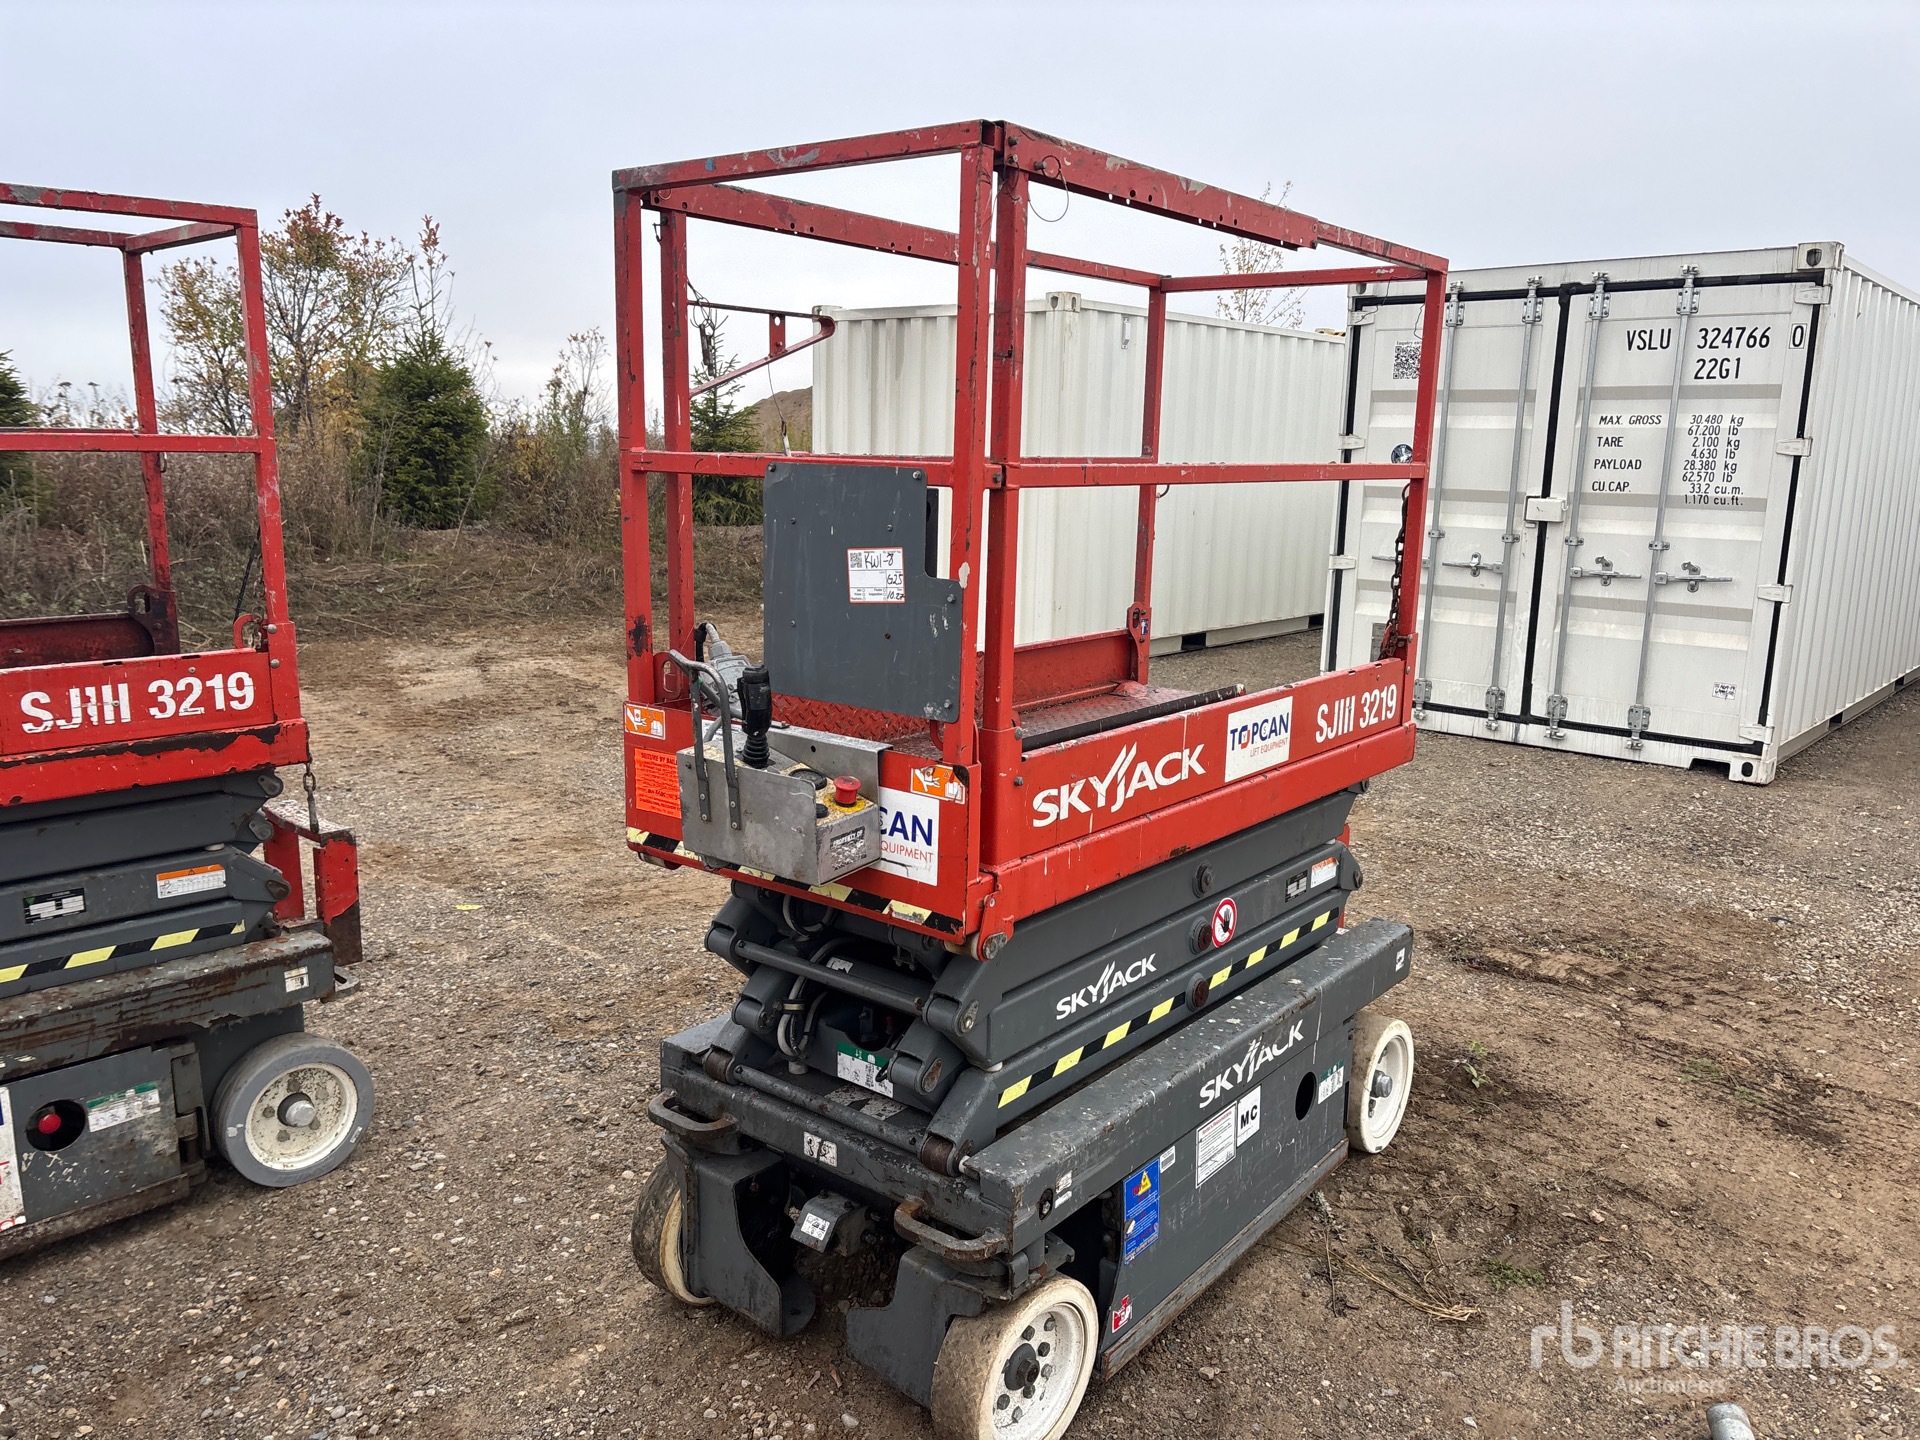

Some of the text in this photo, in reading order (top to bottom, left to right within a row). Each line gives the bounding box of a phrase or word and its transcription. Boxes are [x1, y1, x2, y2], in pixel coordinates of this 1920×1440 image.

[1626, 327, 1672, 351] VSLU
[1696, 326, 1772, 350] 324766
[1693, 357, 1742, 380] 22G1
[1598, 414, 1745, 427] MAX. GROSS 30.480 kg
[1687, 425, 1739, 436] 67.200 lb
[1596, 436, 1741, 450] TARE 2.100 kg
[1690, 448, 1736, 460] 4.630 lb
[1593, 458, 1738, 474] PAYLOAD 28.380 kg
[1681, 471, 1733, 483] 62.570 lb
[1591, 481, 1744, 495] CU.CAP. 33.2 cu.m.
[1684, 494, 1743, 506] 1.170 cu.ft.
[147, 671, 255, 719] 3219
[1315, 683, 1397, 744] SJIII 3219
[1230, 712, 1290, 751] TOPCAN
[1250, 737, 1288, 758] LIFT EQUIPMENT
[1032, 741, 1207, 828] SKYJACK
[881, 840, 934, 863] QUIPMENT
[1056, 952, 1157, 1020] SKYJACK
[1199, 1018, 1305, 1109] SKYJACK
[1240, 1104, 1258, 1130] MC
